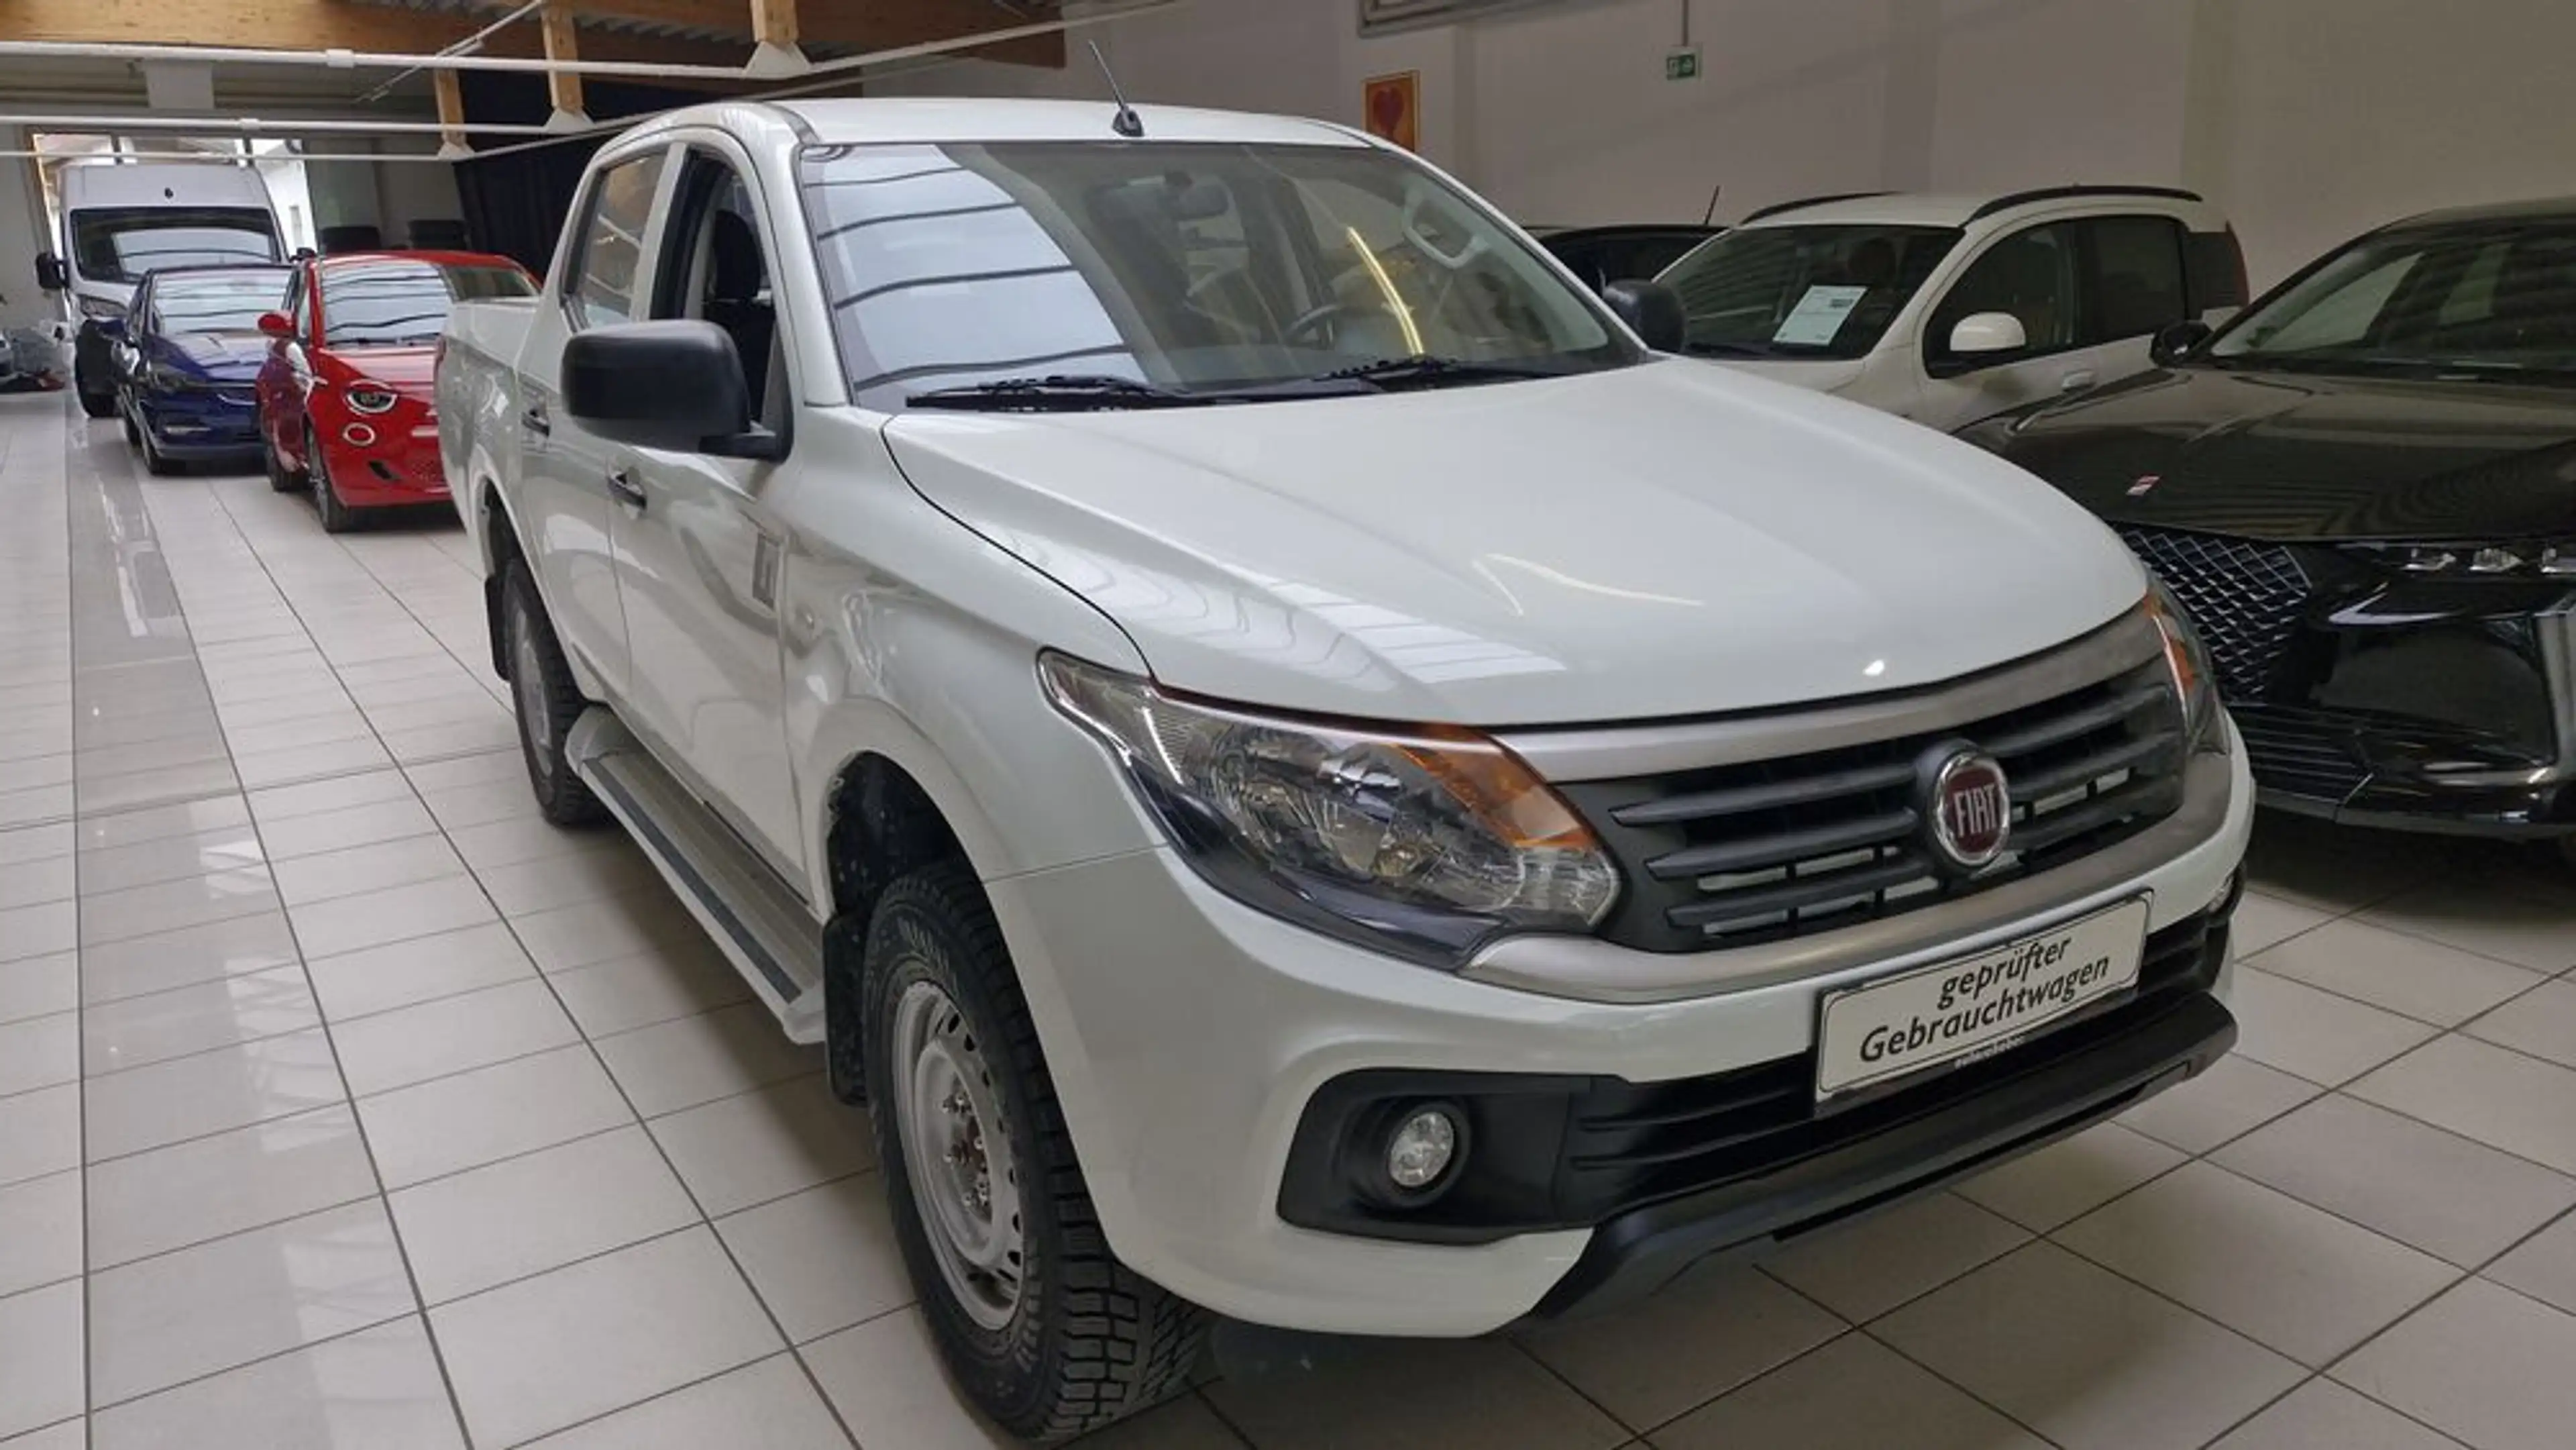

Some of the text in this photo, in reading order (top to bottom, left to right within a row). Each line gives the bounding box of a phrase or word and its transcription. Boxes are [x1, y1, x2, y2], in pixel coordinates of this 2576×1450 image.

[1953, 782, 1996, 838] FIAT
[1860, 955, 2108, 1062] Gebrauchtwagen
[1937, 937, 2072, 1011] geprüfter
